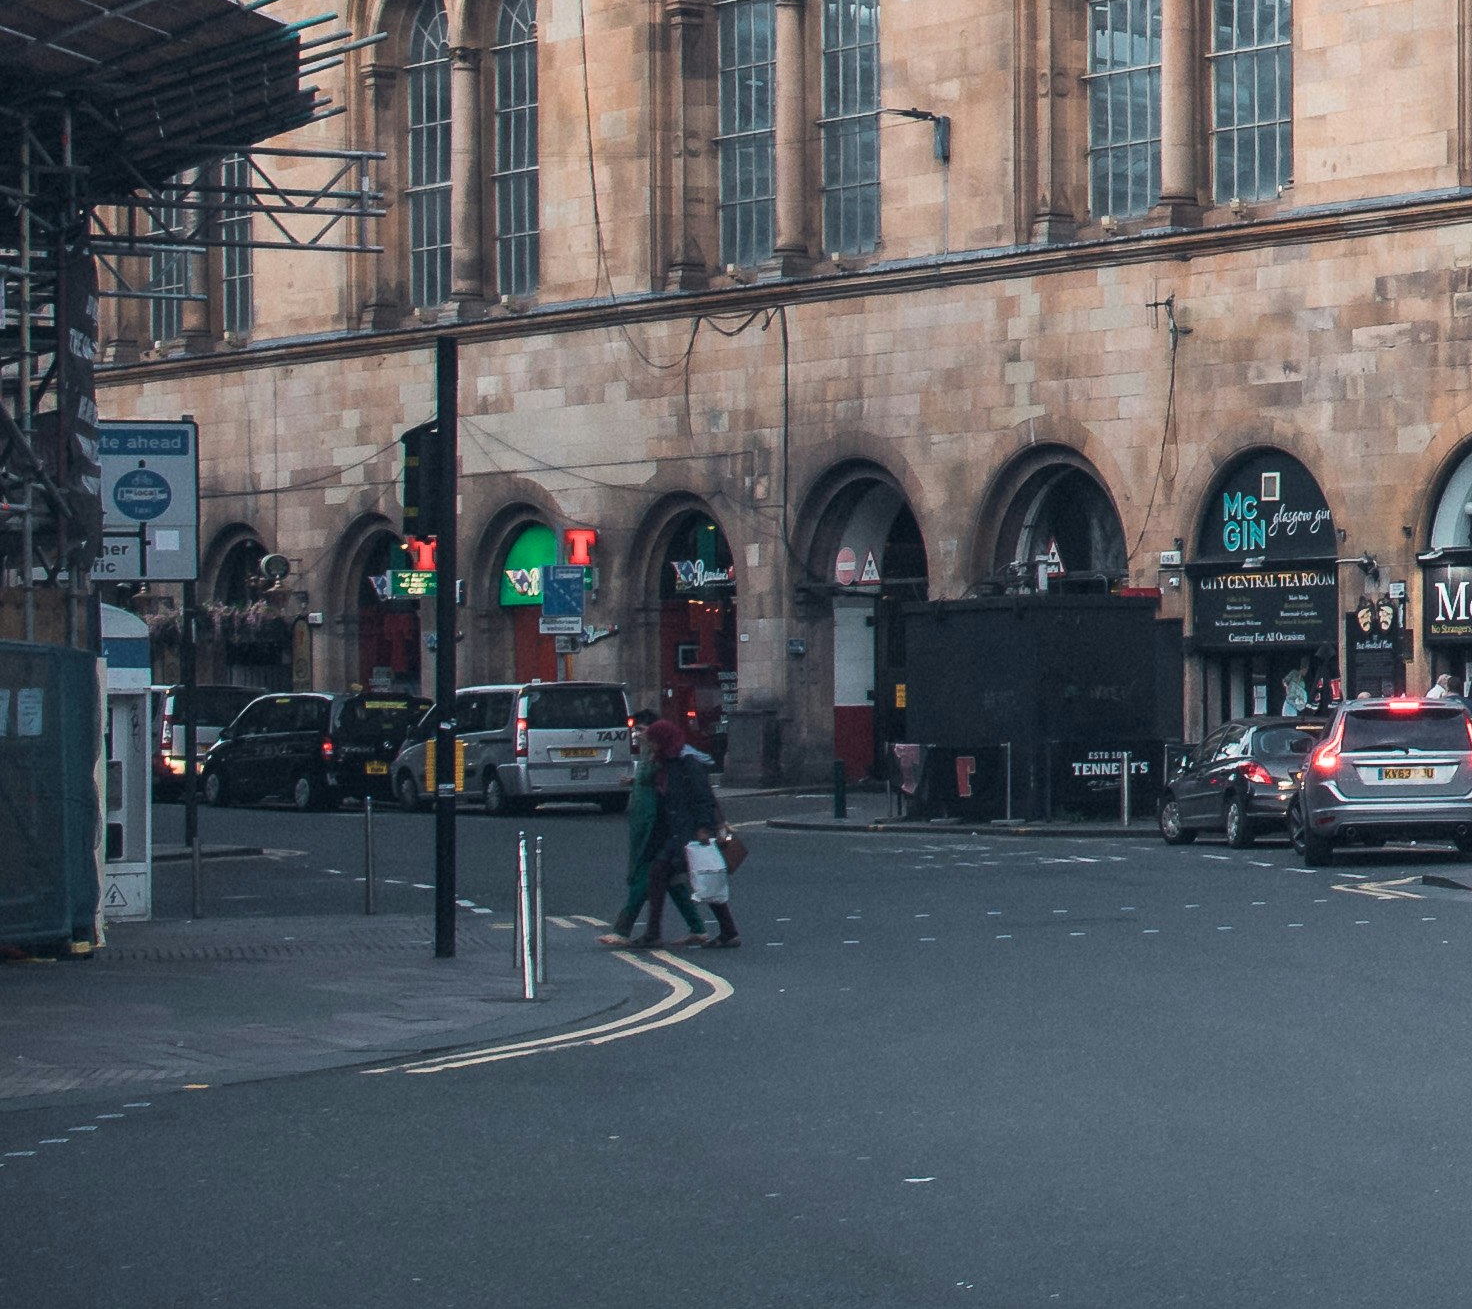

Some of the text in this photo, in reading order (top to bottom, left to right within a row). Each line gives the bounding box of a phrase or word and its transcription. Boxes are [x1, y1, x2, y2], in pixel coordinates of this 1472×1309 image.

[126, 434, 182, 449] ahead
[1223, 519, 1266, 552] GIN
[1200, 572, 1335, 590] CITY CENTRAL TEA ROOM
[1431, 624, 1440, 633] No
[1441, 624, 1472, 635] Strangers,
[1229, 632, 1306, 645] Catering For All Occasions
[596, 731, 628, 742] TAXI
[1071, 761, 1150, 776] TENNET'S
